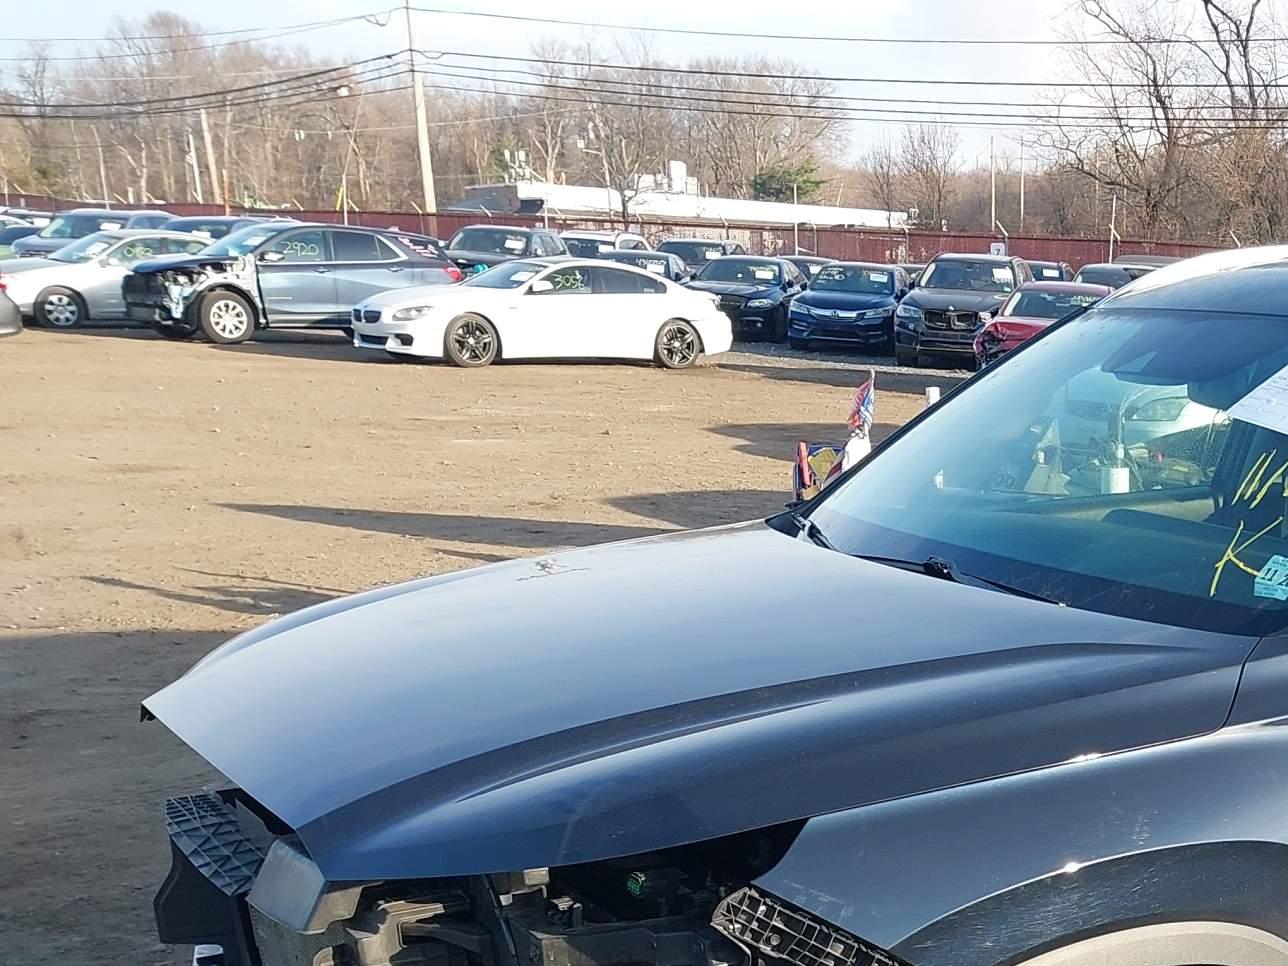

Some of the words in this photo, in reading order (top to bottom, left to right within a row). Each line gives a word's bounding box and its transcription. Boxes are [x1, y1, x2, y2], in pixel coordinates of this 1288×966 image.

[279, 241, 320, 257] 2920
[550, 273, 586, 291] 3056
[1208, 516, 1284, 598] K
[1260, 567, 1279, 582] 11
